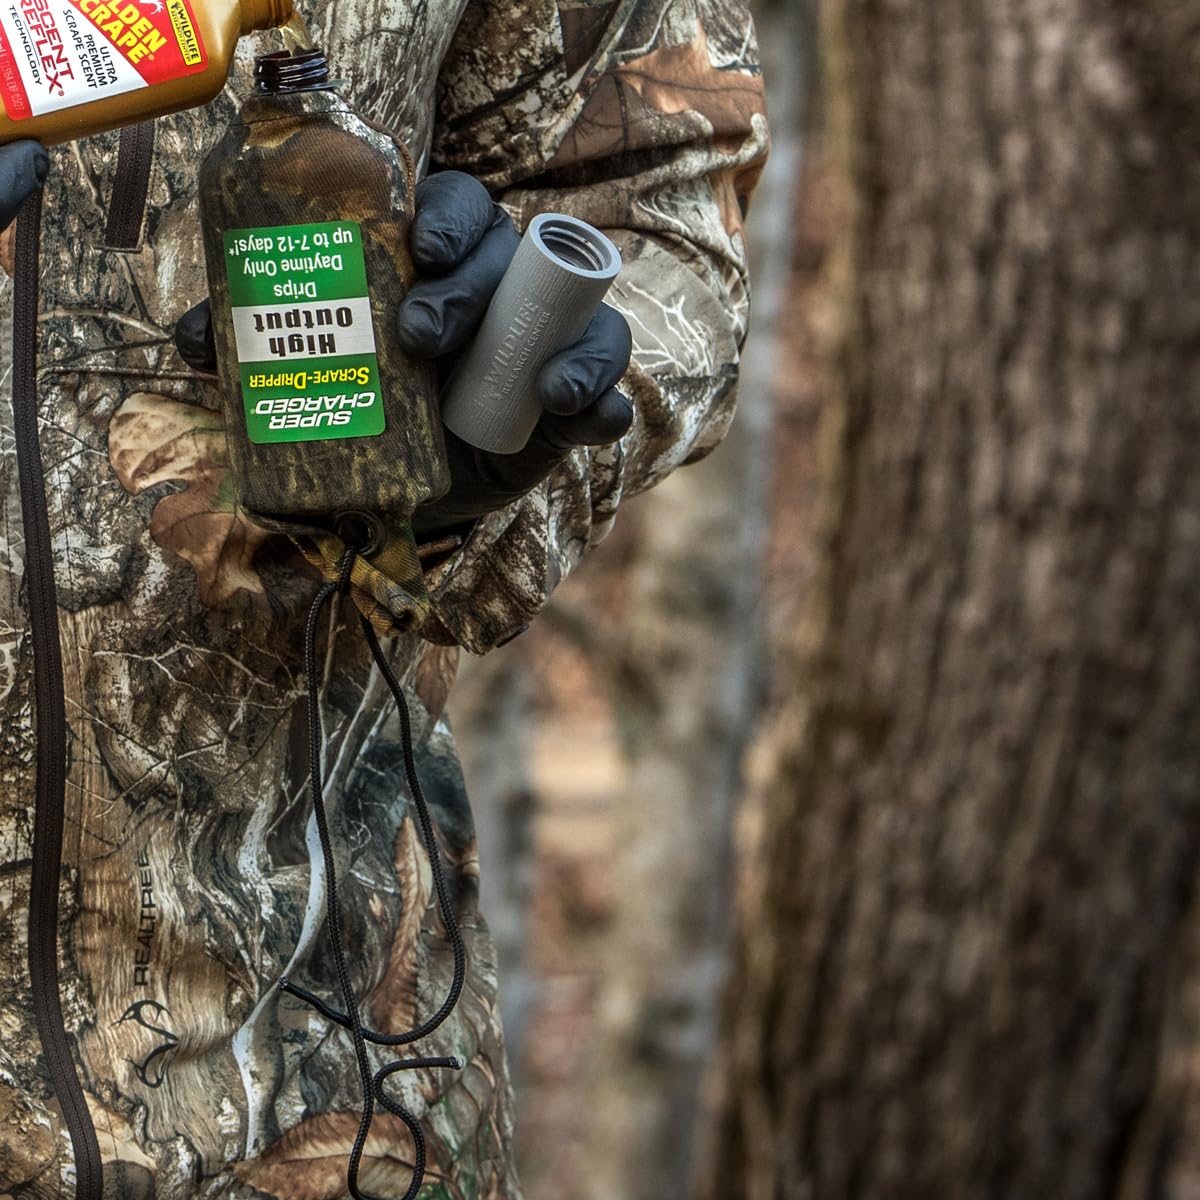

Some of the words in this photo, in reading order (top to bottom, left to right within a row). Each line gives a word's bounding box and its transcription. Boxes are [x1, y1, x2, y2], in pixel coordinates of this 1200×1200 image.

[9, 5, 42, 85] TECHNOLOGY
[177, 8, 200, 60] WILDLIFE
[63, 9, 85, 51] SCRAPE
[78, 54, 97, 88] SCENT
[84, 34, 108, 86] PREMIUM
[100, 46, 118, 84] ULTRA
[277, 235, 310, 251] 7-12
[313, 231, 329, 246] to
[332, 227, 353, 243] up
[243, 260, 277, 278] Only
[281, 254, 343, 274] Daytime
[274, 281, 317, 298] Drips
[253, 307, 353, 332] Output
[269, 333, 336, 357] High
[484, 297, 540, 387] WILDLIFE
[503, 342, 532, 395] RESEARCH
[528, 311, 551, 347] CENTER
[250, 367, 370, 389] SCRAPE-DRIPPER
[255, 392, 376, 415] CHARGED
[268, 410, 353, 430] SUPER
[134, 850, 158, 987] REALTREE
